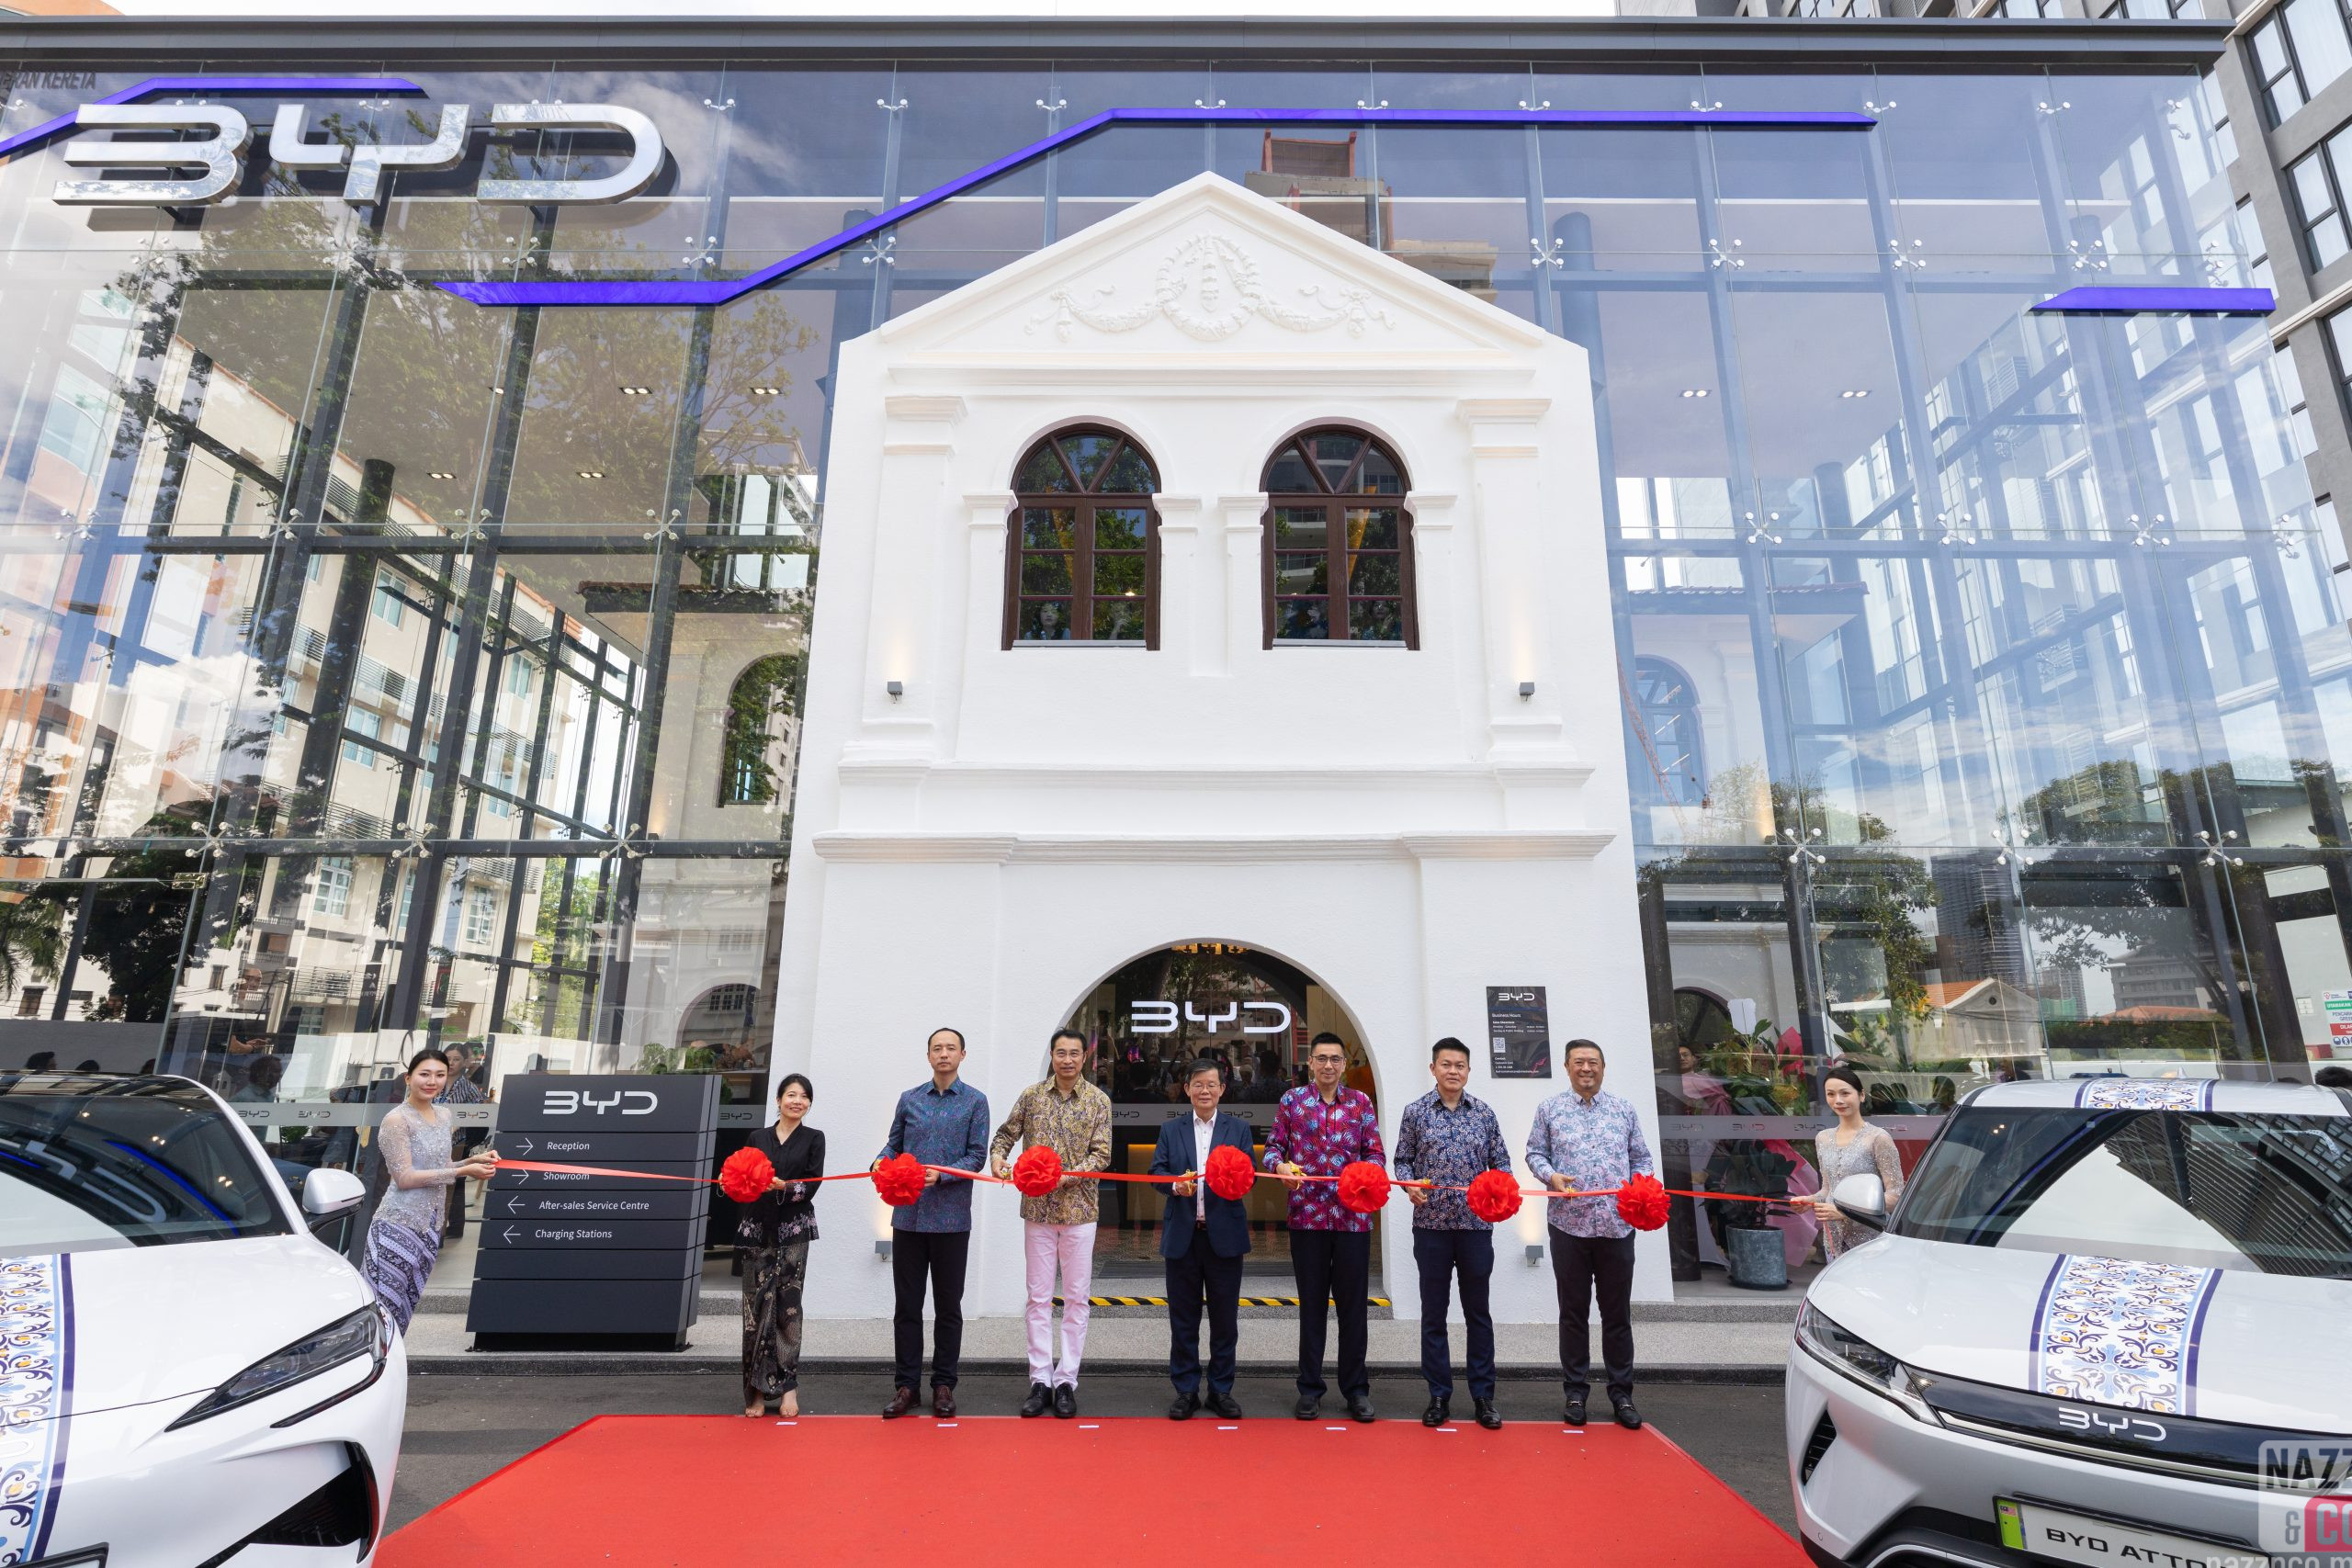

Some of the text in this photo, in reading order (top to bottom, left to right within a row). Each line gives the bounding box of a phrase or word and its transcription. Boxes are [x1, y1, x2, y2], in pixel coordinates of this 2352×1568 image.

[41, 72, 96, 89] KERETA
[51, 103, 665, 207] BYD
[1498, 993, 1535, 1001] BYD
[1131, 1000, 1292, 1033] BYD
[542, 1090, 659, 1115] BYD
[238, 1110, 270, 1118] BYD
[298, 1110, 331, 1119] BYD
[457, 1111, 489, 1119] BYD
[719, 1112, 753, 1121] BYD
[547, 1141, 590, 1152] Reception
[543, 1171, 590, 1180] Showroom
[538, 1200, 650, 1210] After-sales Service Centre
[535, 1228, 613, 1240] Charging Stations
[2057, 1406, 2167, 1442] BYD
[2045, 1528, 2109, 1553] BYD
